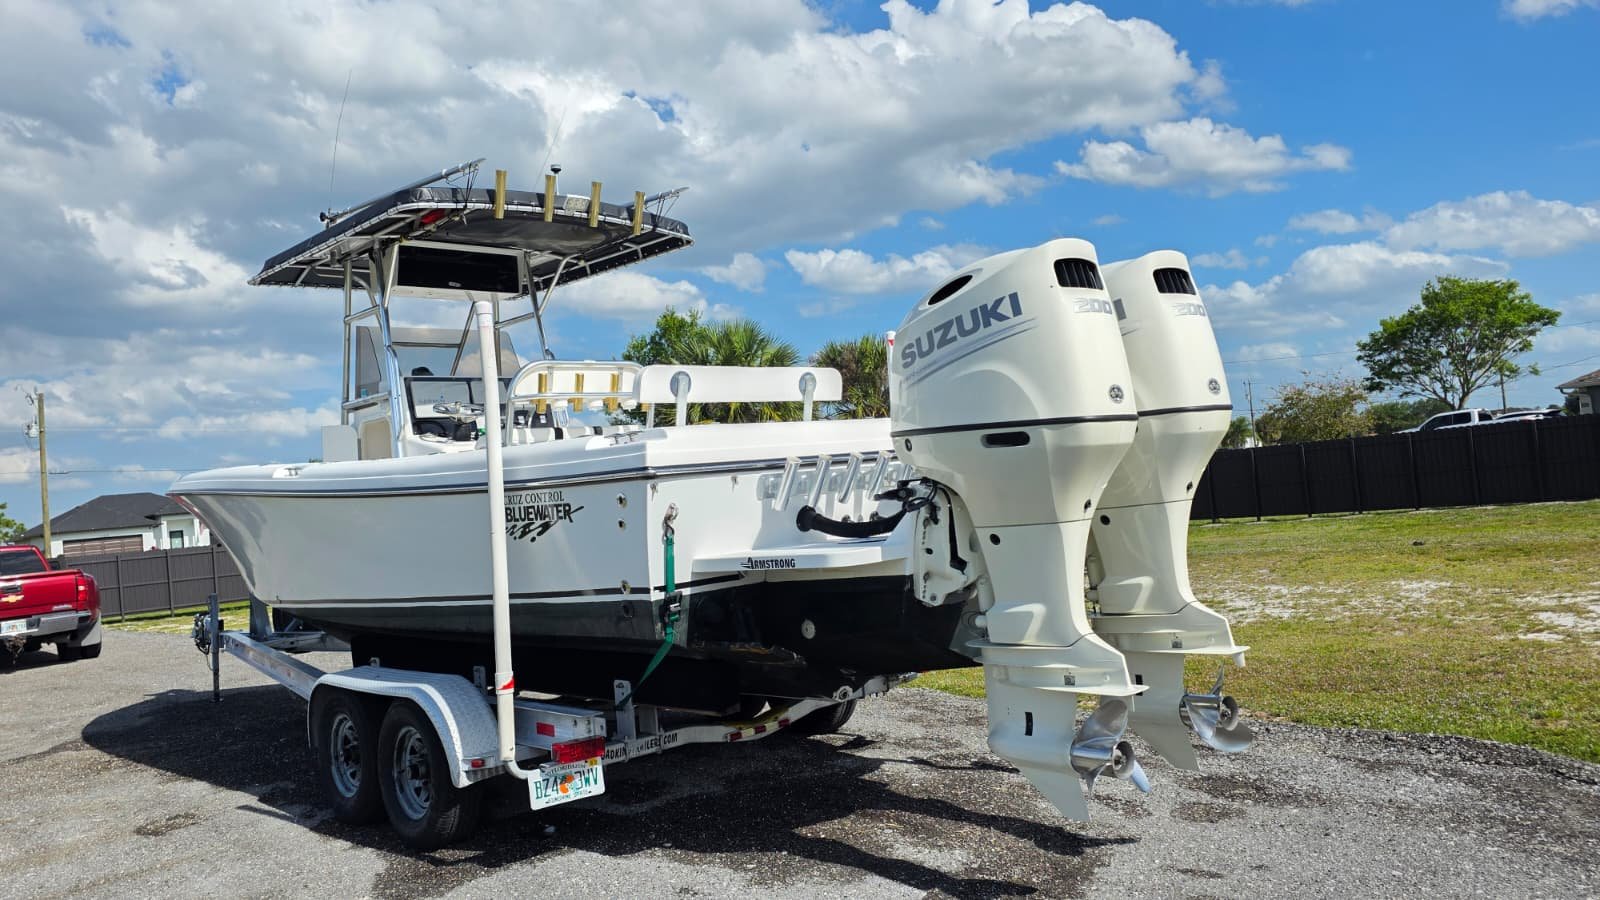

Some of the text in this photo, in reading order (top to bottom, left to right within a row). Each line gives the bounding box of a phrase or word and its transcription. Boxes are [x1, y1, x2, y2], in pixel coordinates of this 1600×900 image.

[1075, 297, 1113, 315] 200
[901, 291, 1023, 369] SUZUKI
[524, 490, 565, 505] CONTROL
[505, 503, 574, 523] BLUEWATER
[746, 557, 796, 569] ARMSTRONG
[533, 775, 559, 800] BZ4
[574, 766, 598, 791] 3WV
